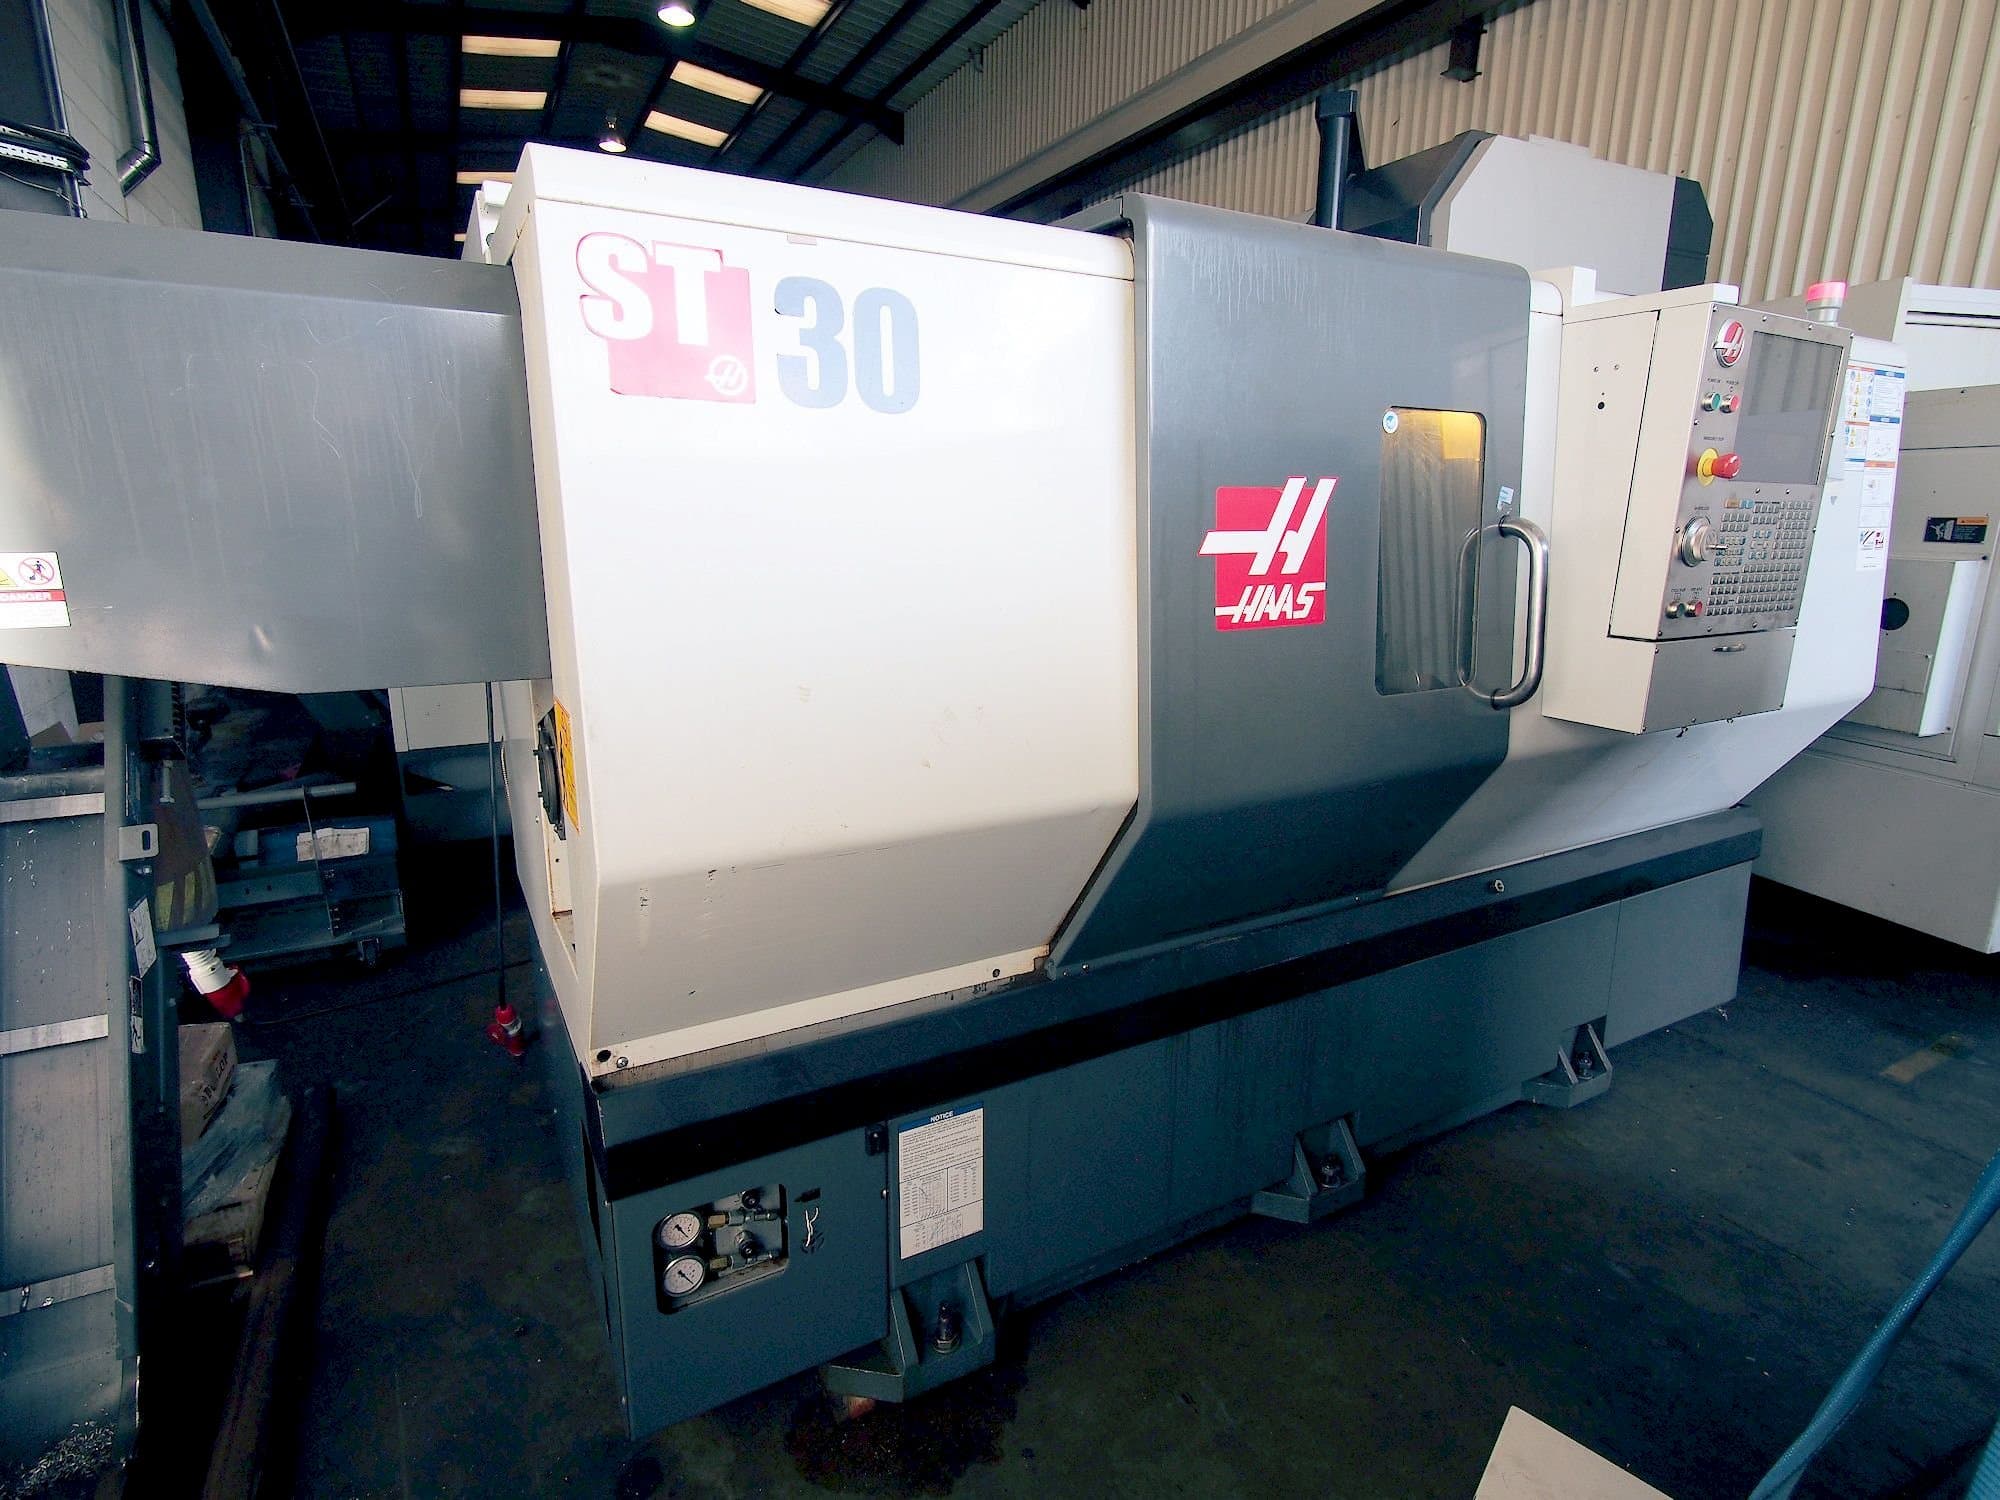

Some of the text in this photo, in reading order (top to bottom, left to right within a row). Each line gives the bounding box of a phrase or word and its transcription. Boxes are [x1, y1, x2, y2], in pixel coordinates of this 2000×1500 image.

[576, 231, 921, 415] ST 30
[1215, 582, 1328, 624] HAAS
[929, 1110, 955, 1123] NOTICE
